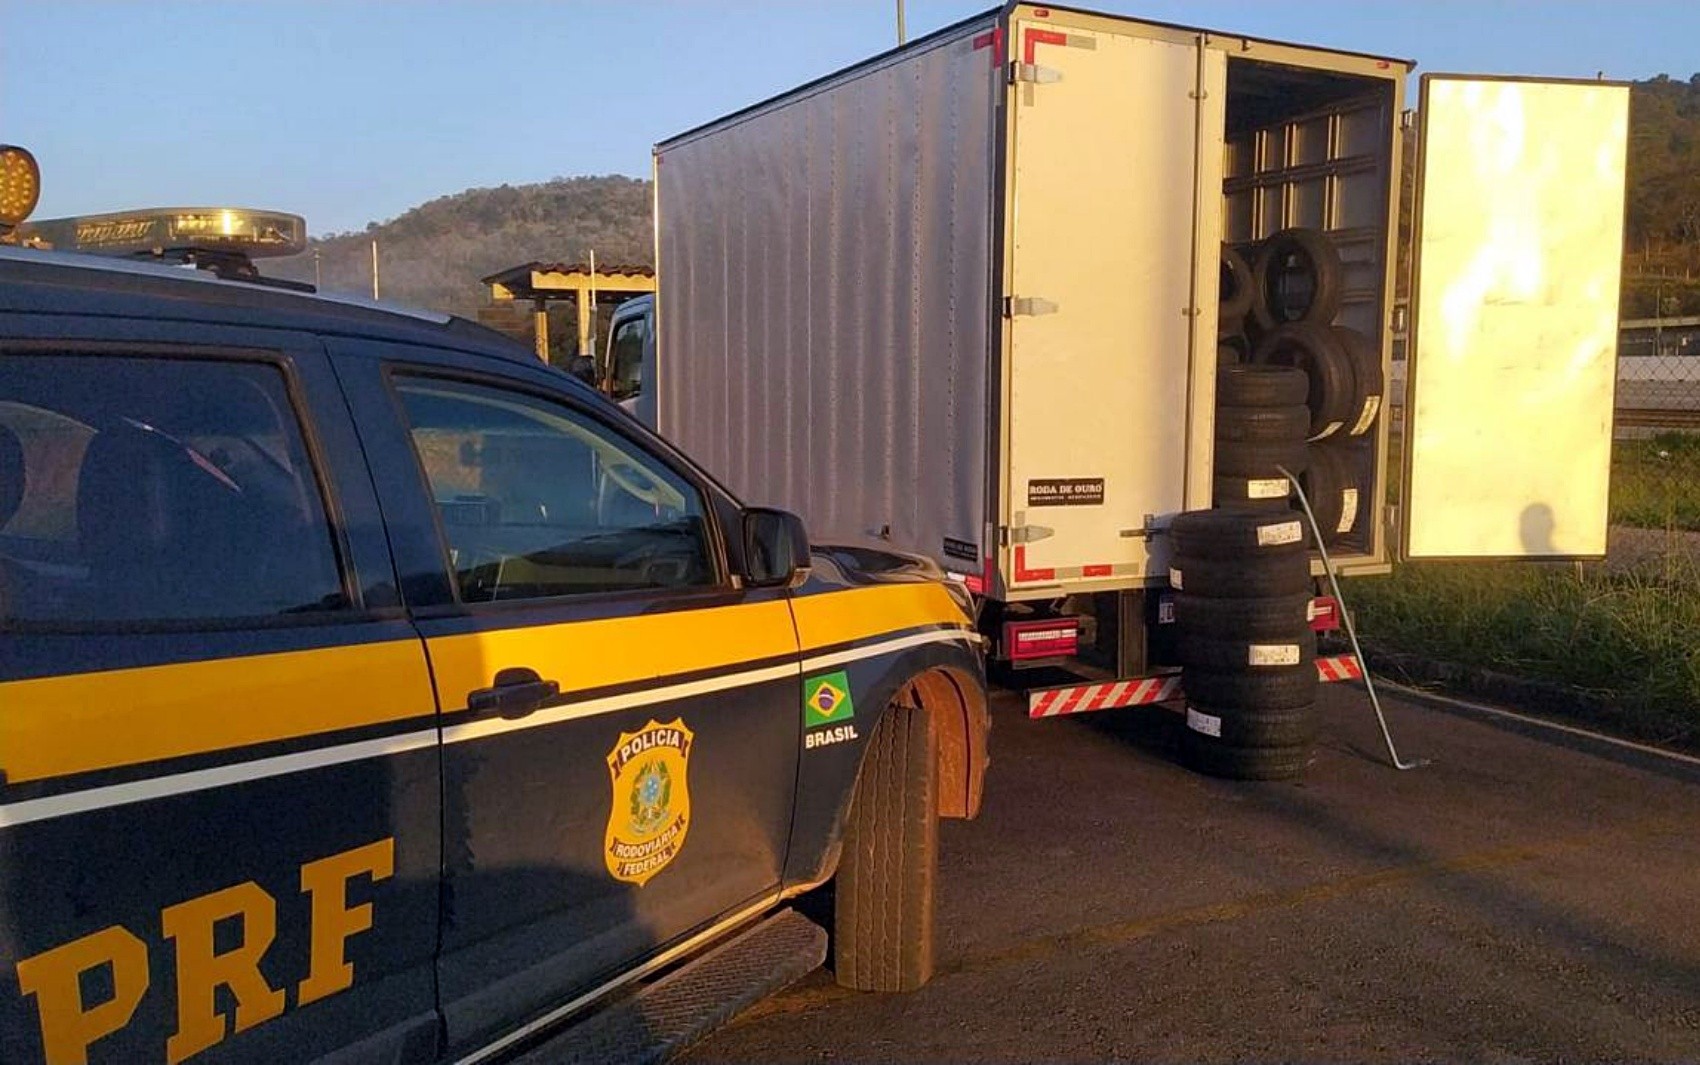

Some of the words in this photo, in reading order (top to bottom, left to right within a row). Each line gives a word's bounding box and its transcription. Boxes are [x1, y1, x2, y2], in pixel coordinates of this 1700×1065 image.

[1029, 485, 1057, 494] RODA
[1060, 485, 1073, 494] DE
[1074, 484, 1102, 493] OURO
[805, 725, 858, 749] BRASIL
[623, 850, 669, 875] FEDERAL
[16, 837, 394, 1065] PRF
